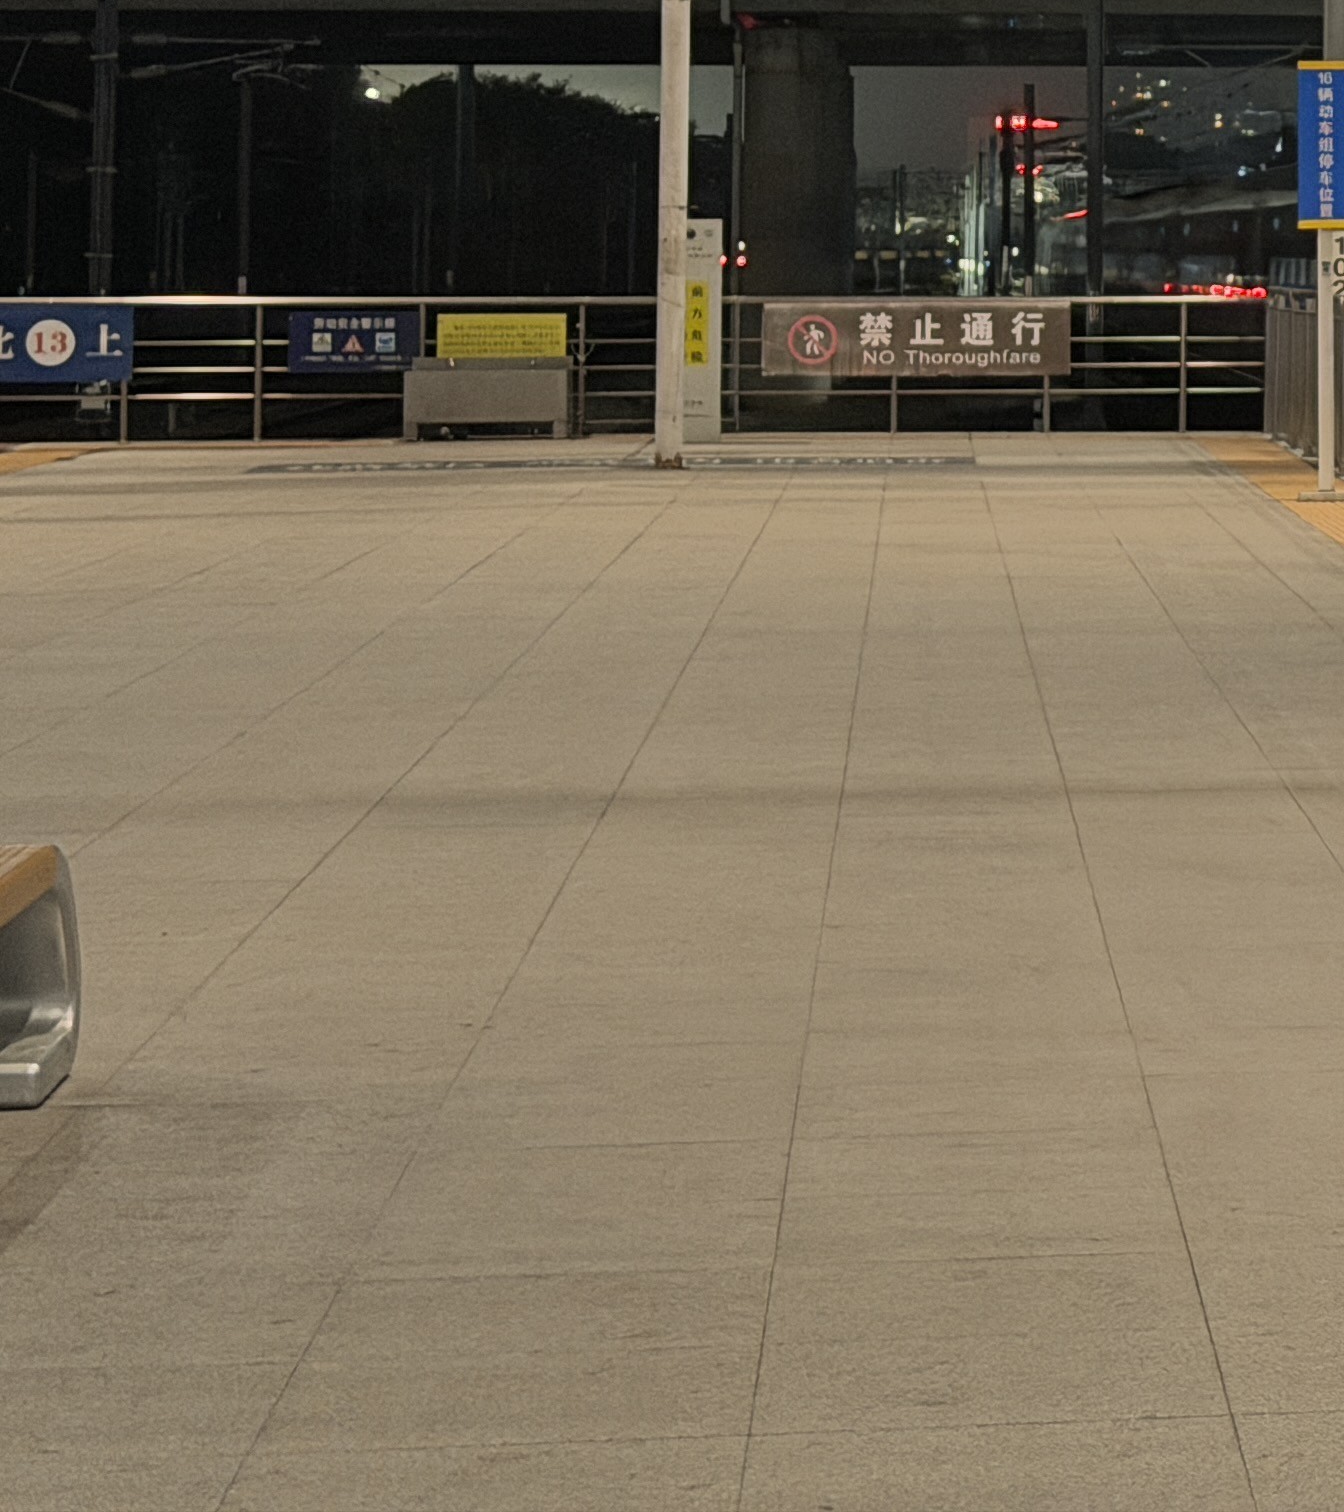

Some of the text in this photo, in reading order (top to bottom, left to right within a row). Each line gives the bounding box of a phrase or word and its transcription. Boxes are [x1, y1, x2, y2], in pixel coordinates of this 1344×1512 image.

[859, 311, 1046, 347] 禁止通行
[34, 331, 69, 355] 13
[863, 348, 1041, 368] NO Thoroughfare
